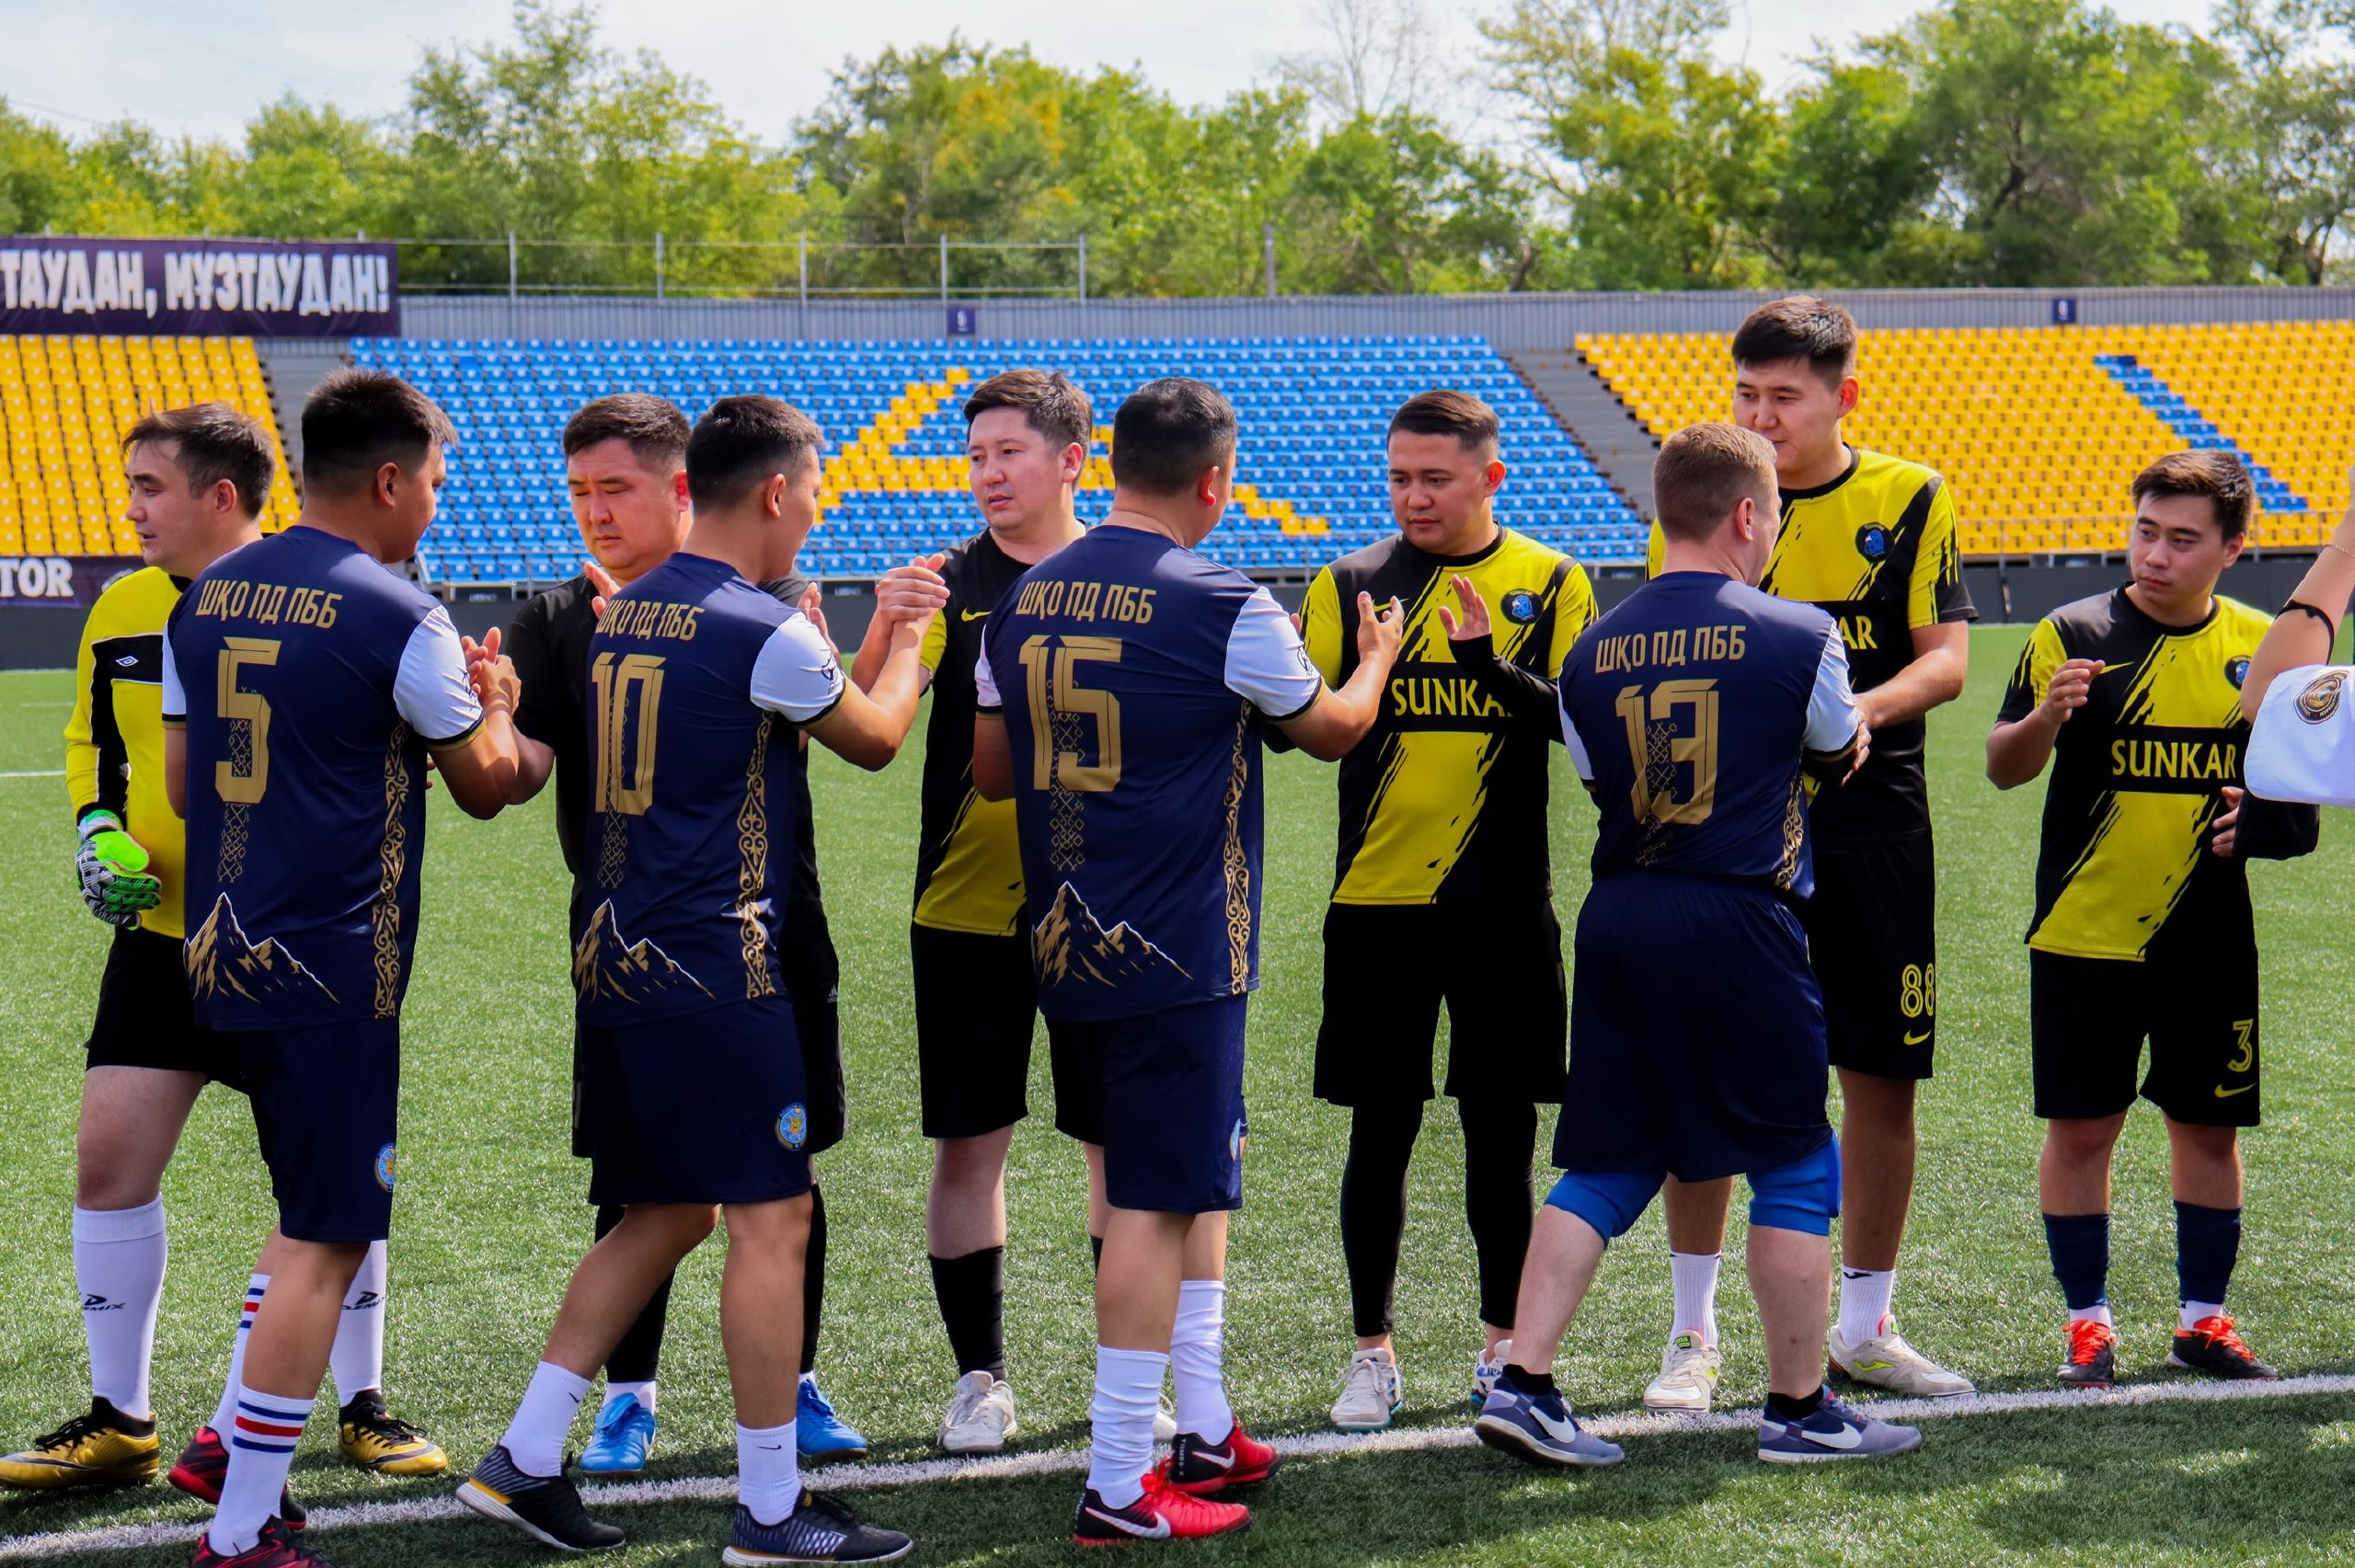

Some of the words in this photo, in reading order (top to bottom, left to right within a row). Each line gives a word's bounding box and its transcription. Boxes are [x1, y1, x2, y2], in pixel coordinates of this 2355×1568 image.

[0, 556, 74, 598] TOR
[247, 583, 287, 624] ПД
[284, 588, 343, 629] ПББ
[628, 601, 660, 639] ПД
[655, 603, 705, 641] ПББ
[1063, 581, 1101, 623] ПД
[1101, 584, 1156, 624] ПББ
[1651, 629, 1686, 668] ПД
[1693, 625, 1746, 661] ПББ
[215, 636, 281, 804] 5
[1018, 635, 1122, 792] 15
[1391, 678, 1513, 717] SUNKA
[592, 652, 666, 816] 10
[1614, 678, 1719, 826] 13
[2111, 739, 2236, 779] SUNKAR
[1901, 963, 1935, 1018] 88
[2227, 1018, 2254, 1072] 3
